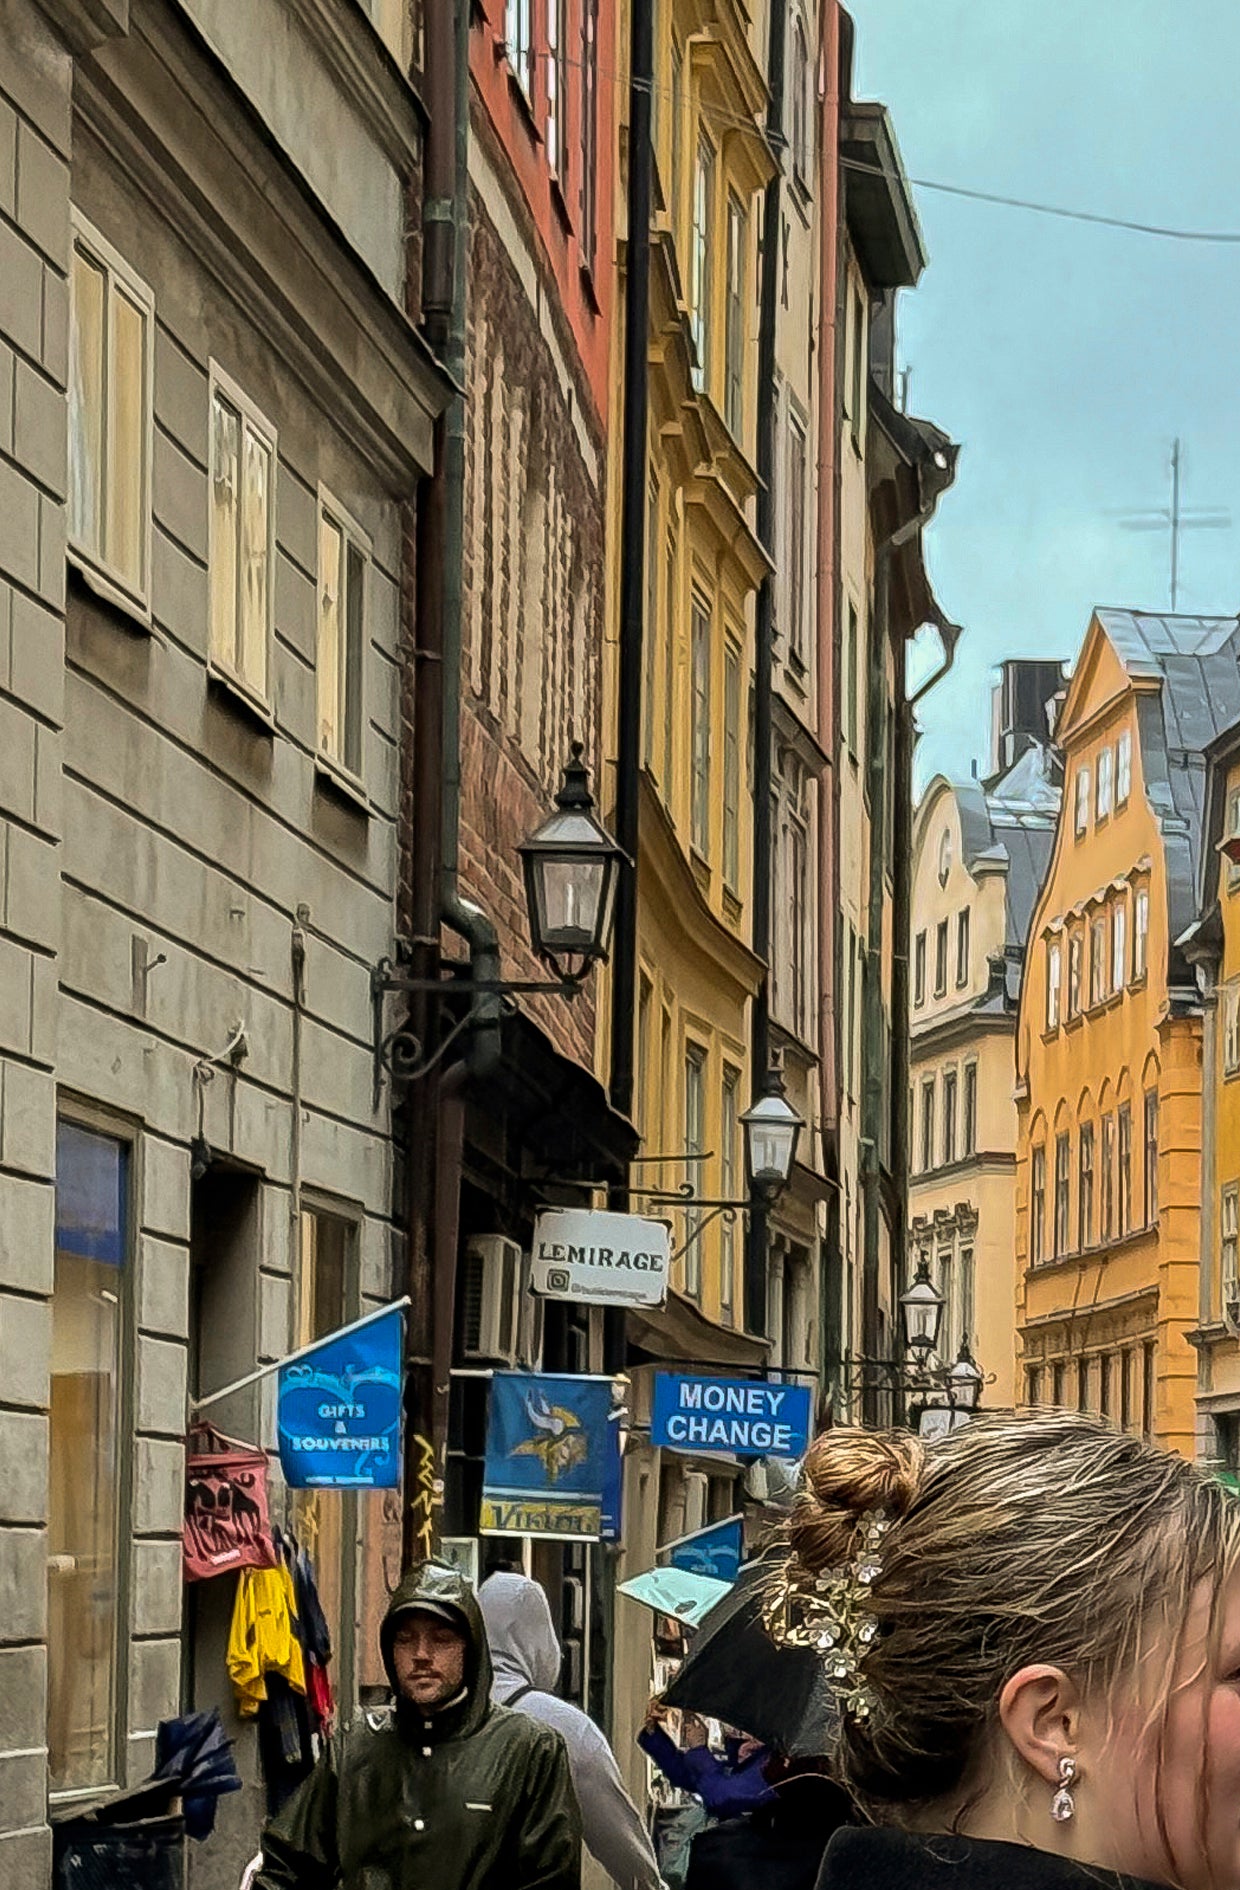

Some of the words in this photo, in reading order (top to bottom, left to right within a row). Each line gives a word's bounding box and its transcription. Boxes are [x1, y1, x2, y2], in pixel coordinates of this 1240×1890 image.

[318, 1404, 365, 1418] GIFTS
[679, 1382, 786, 1417] MONEY
[667, 1414, 792, 1450] CHANGE
